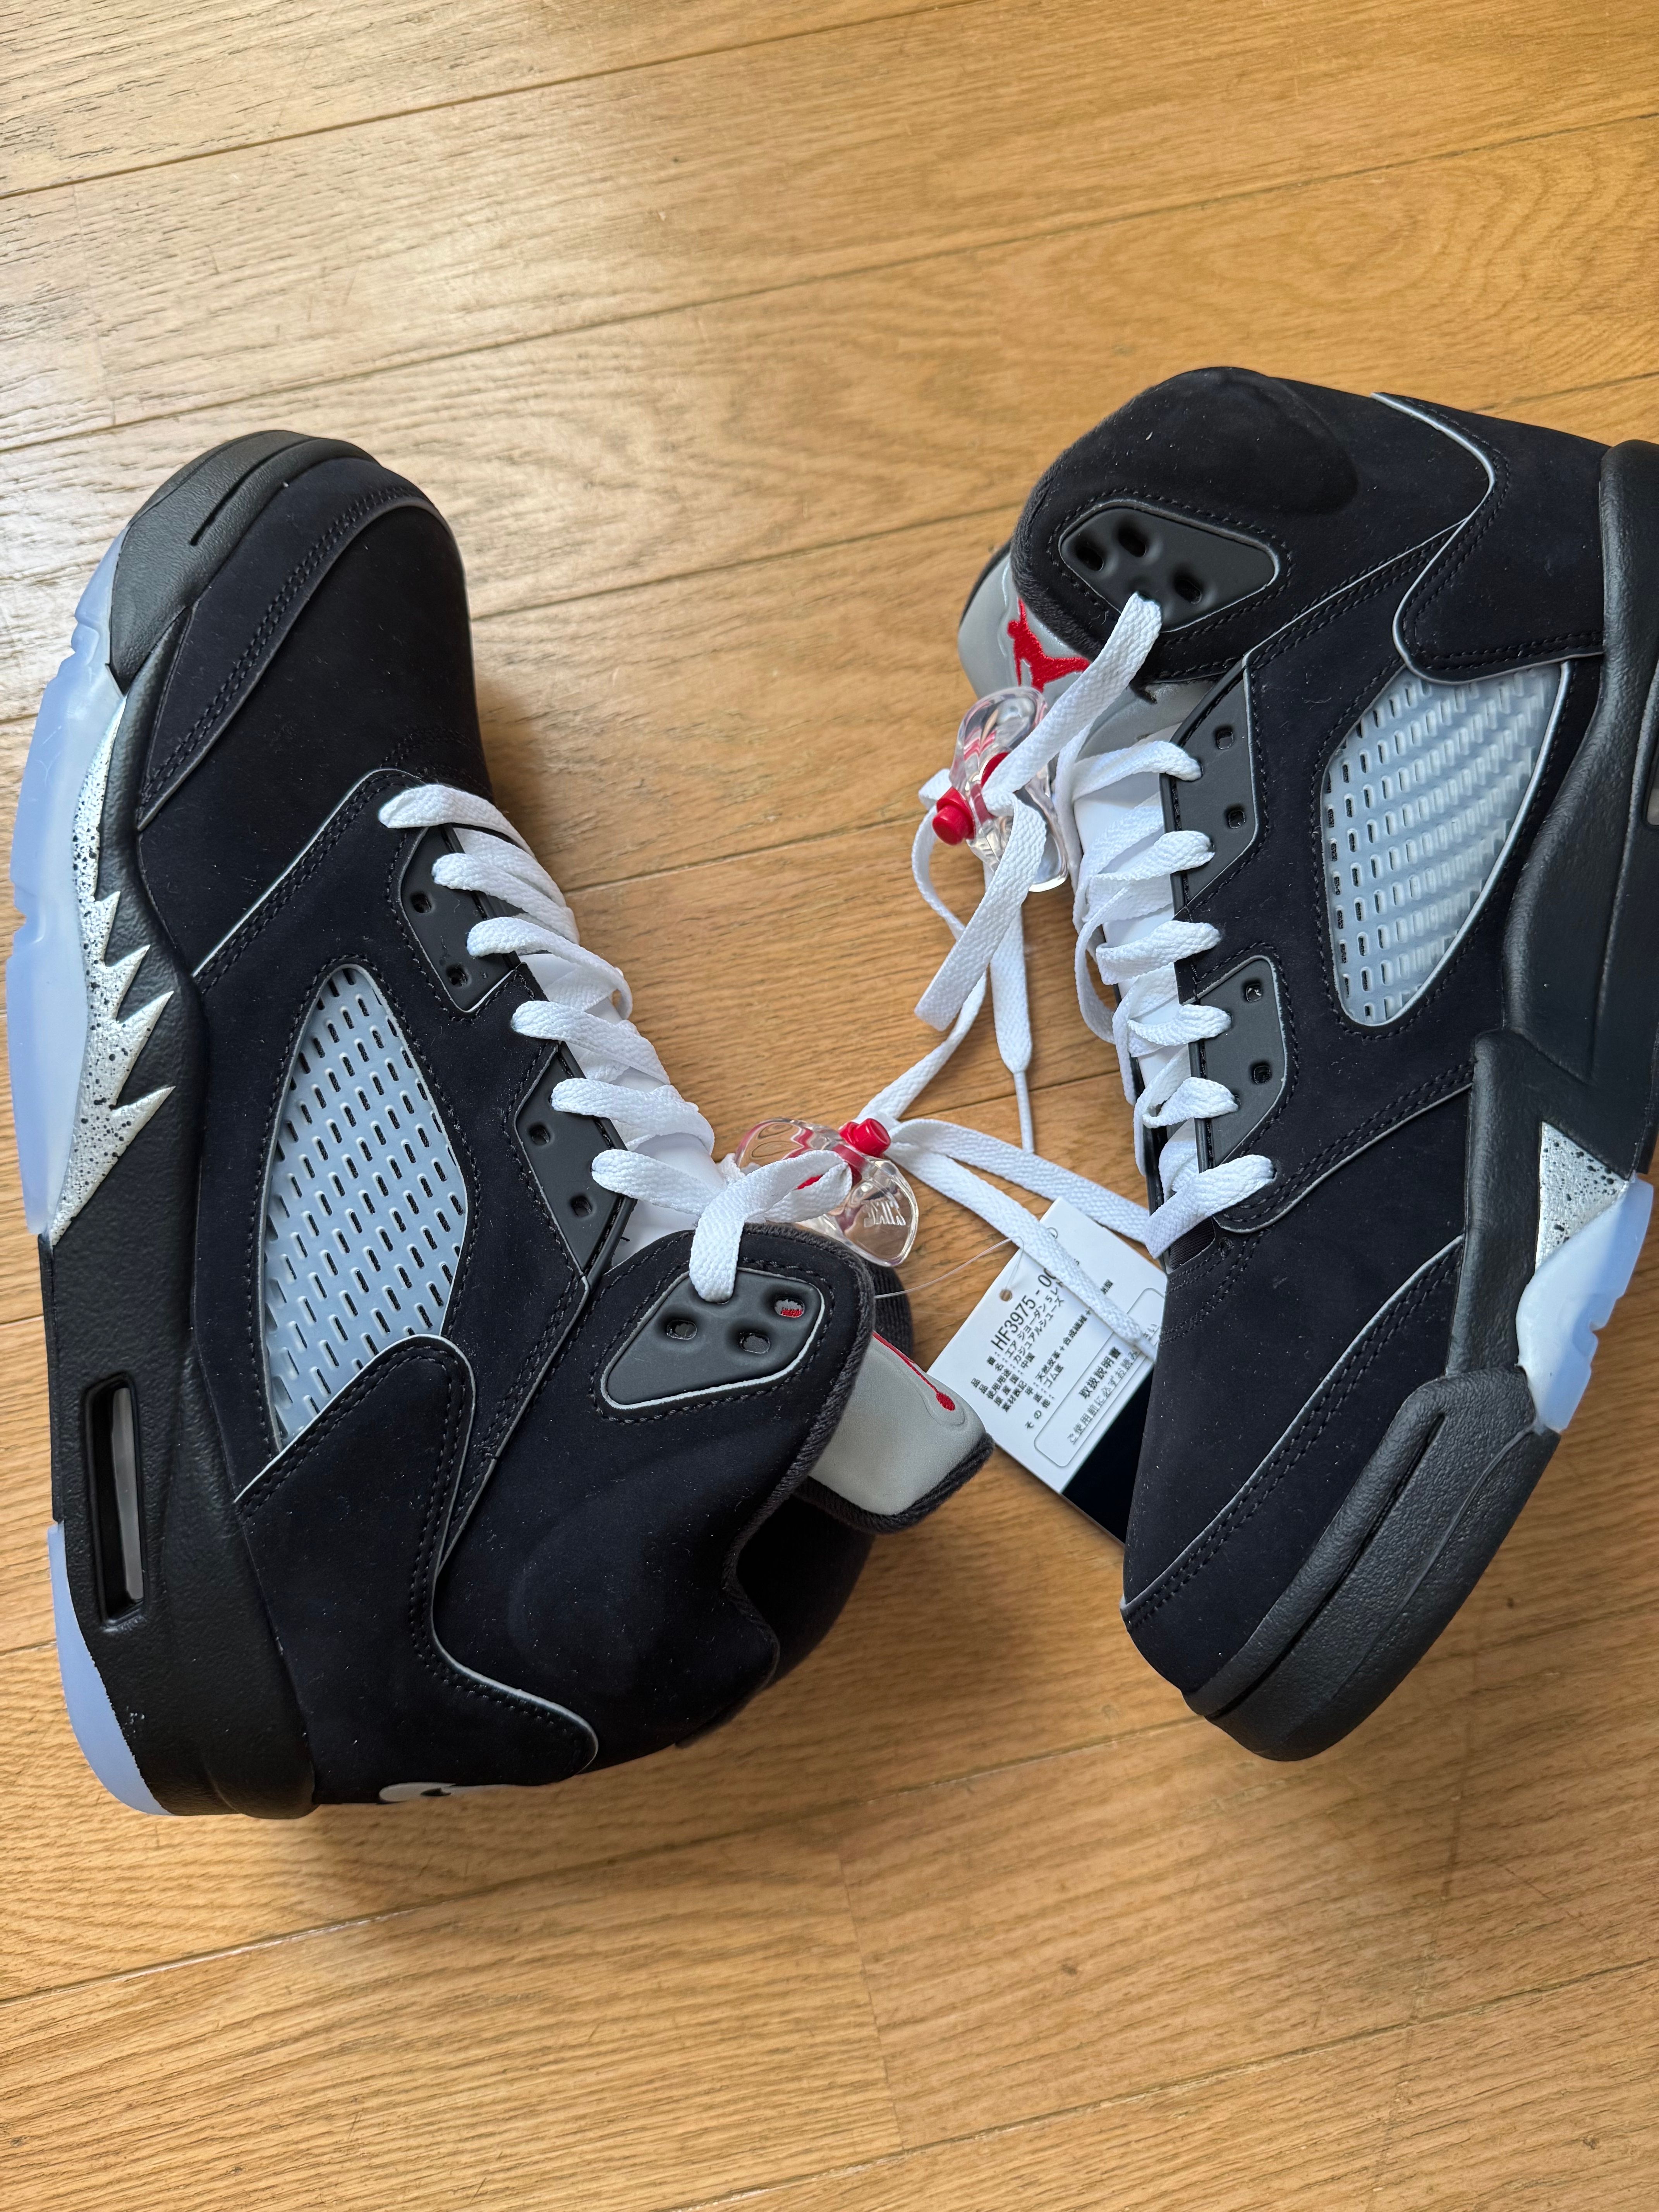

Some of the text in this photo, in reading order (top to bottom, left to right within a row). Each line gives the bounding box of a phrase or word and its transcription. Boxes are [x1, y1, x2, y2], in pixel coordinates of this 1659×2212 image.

[989, 1294, 1037, 1352] HF3975
[1004, 1339, 1017, 1358] エア
[1016, 1302, 1046, 1341] ジョーダン
[1044, 1294, 1053, 1304] 5
[1012, 1295, 1065, 1365] カジュアルシューズ
[1019, 1352, 1036, 1370] 中国
[1042, 1362, 1065, 1389] ゴム底
[1077, 1346, 1121, 1400] 取扱説明書
